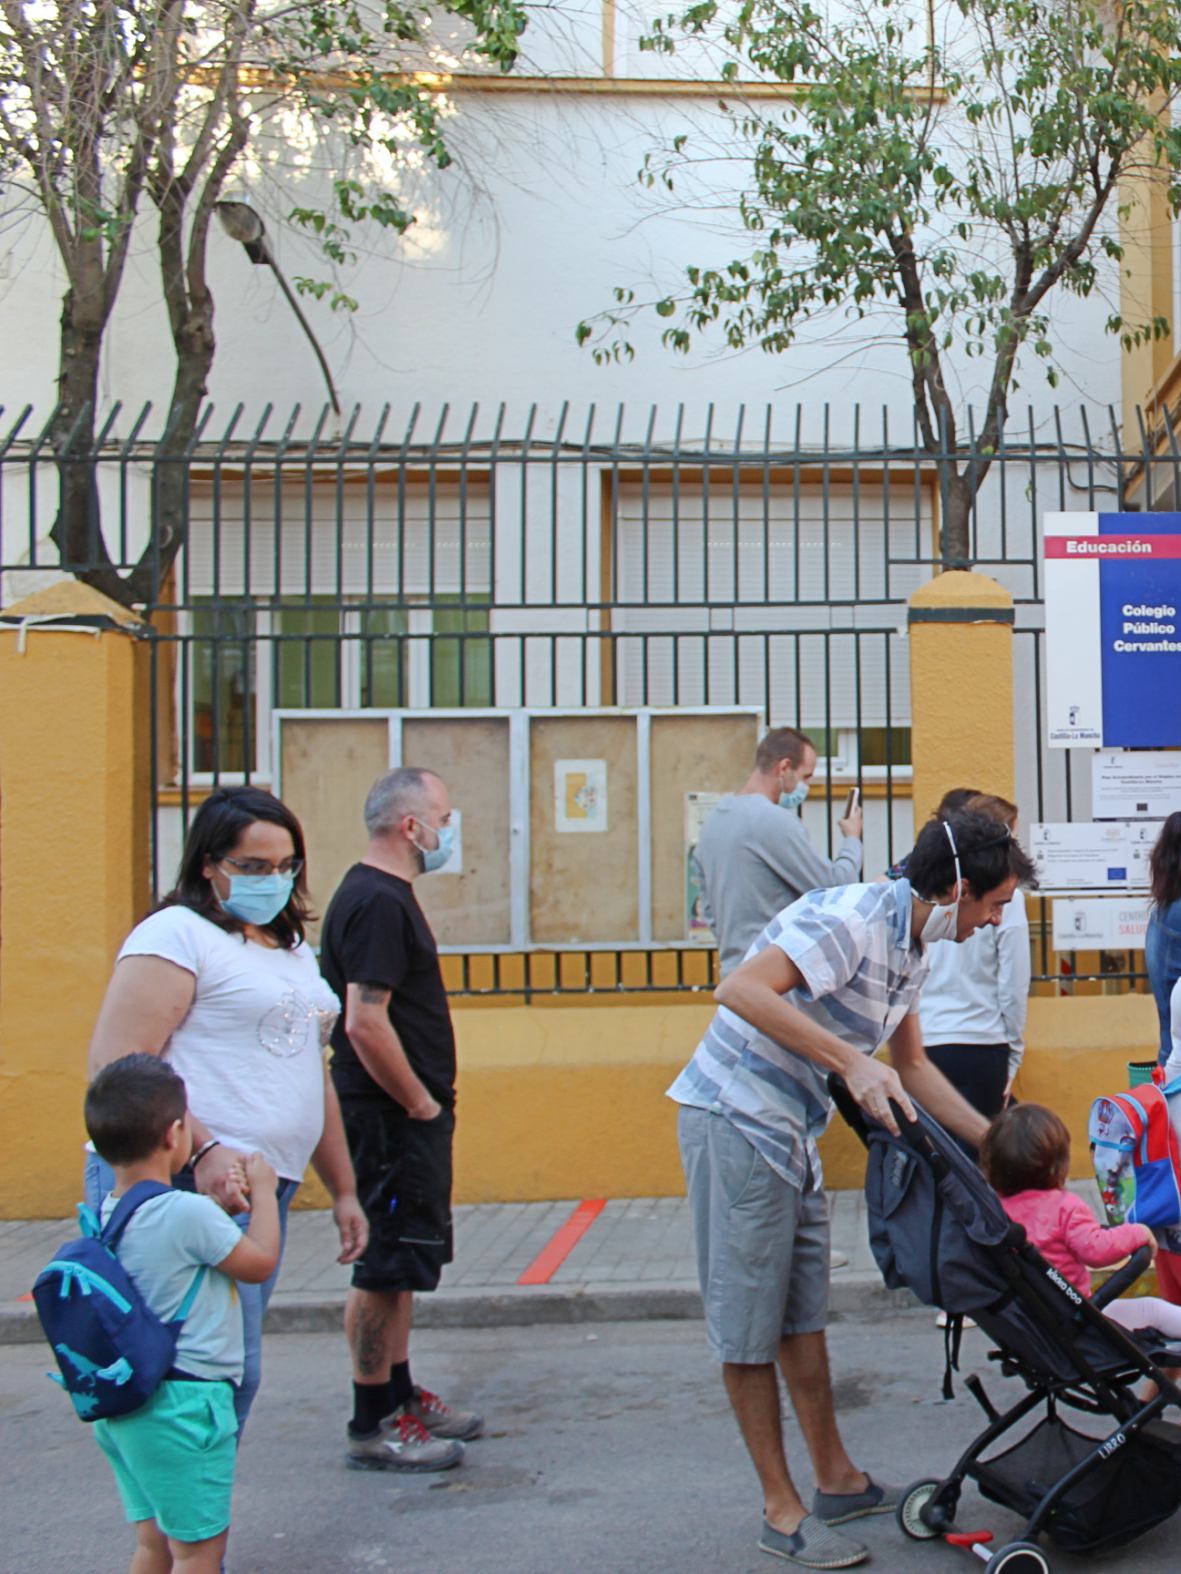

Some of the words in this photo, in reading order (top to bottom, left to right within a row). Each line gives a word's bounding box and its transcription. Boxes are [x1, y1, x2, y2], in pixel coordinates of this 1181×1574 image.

[1066, 540, 1152, 554] Educación
[1122, 604, 1176, 619] Colegio
[1123, 622, 1176, 634] Público
